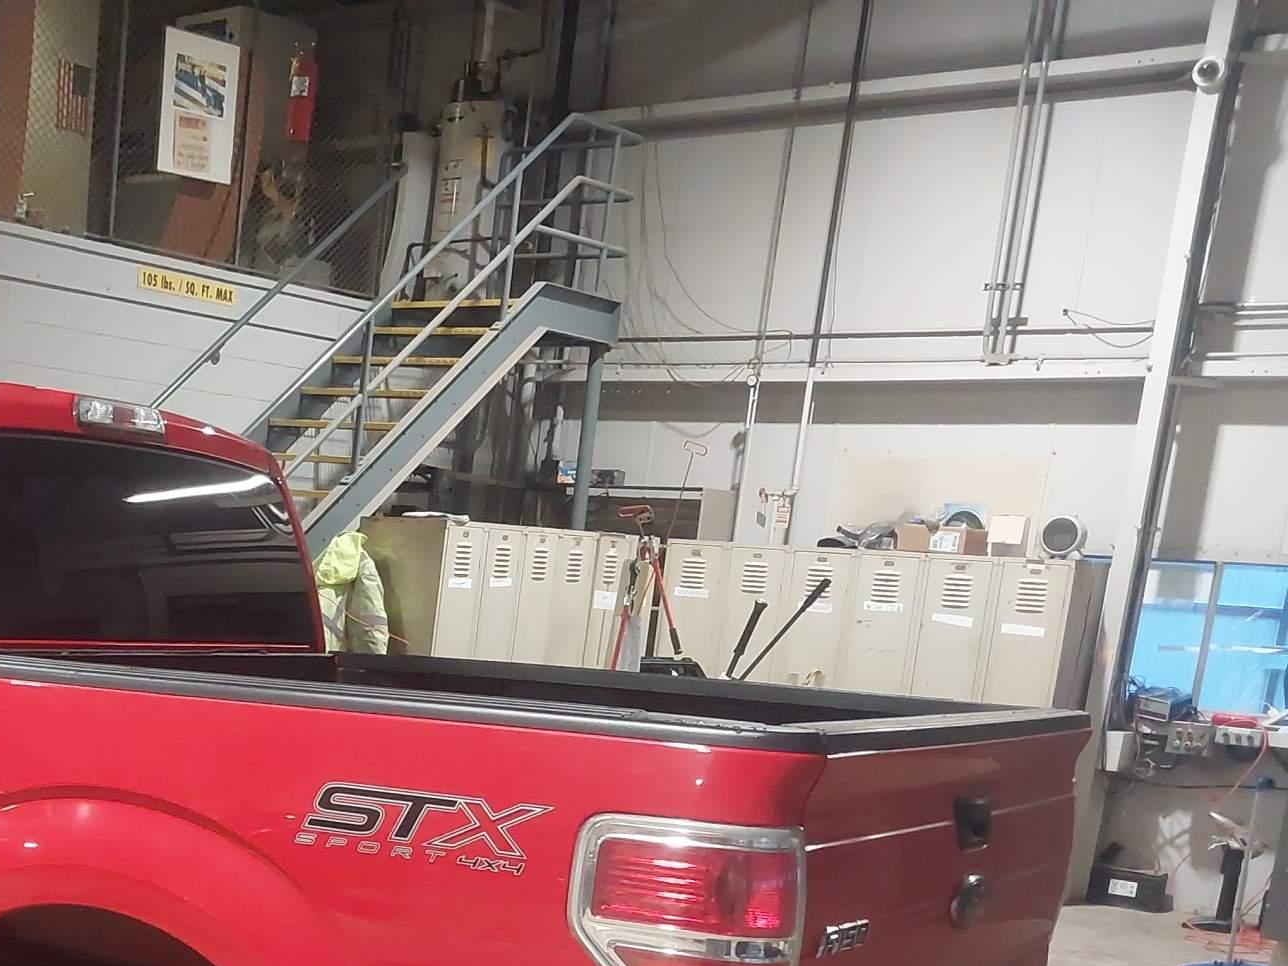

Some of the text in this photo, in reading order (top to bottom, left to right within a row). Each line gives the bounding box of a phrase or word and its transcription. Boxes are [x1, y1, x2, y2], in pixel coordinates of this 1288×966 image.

[143, 271, 158, 287] 105
[161, 274, 175, 292] lbs.
[185, 281, 198, 296] SQ.
[202, 284, 212, 299] FT.
[215, 287, 234, 303] MAX
[301, 781, 556, 860] STX
[294, 832, 447, 863] SPORT
